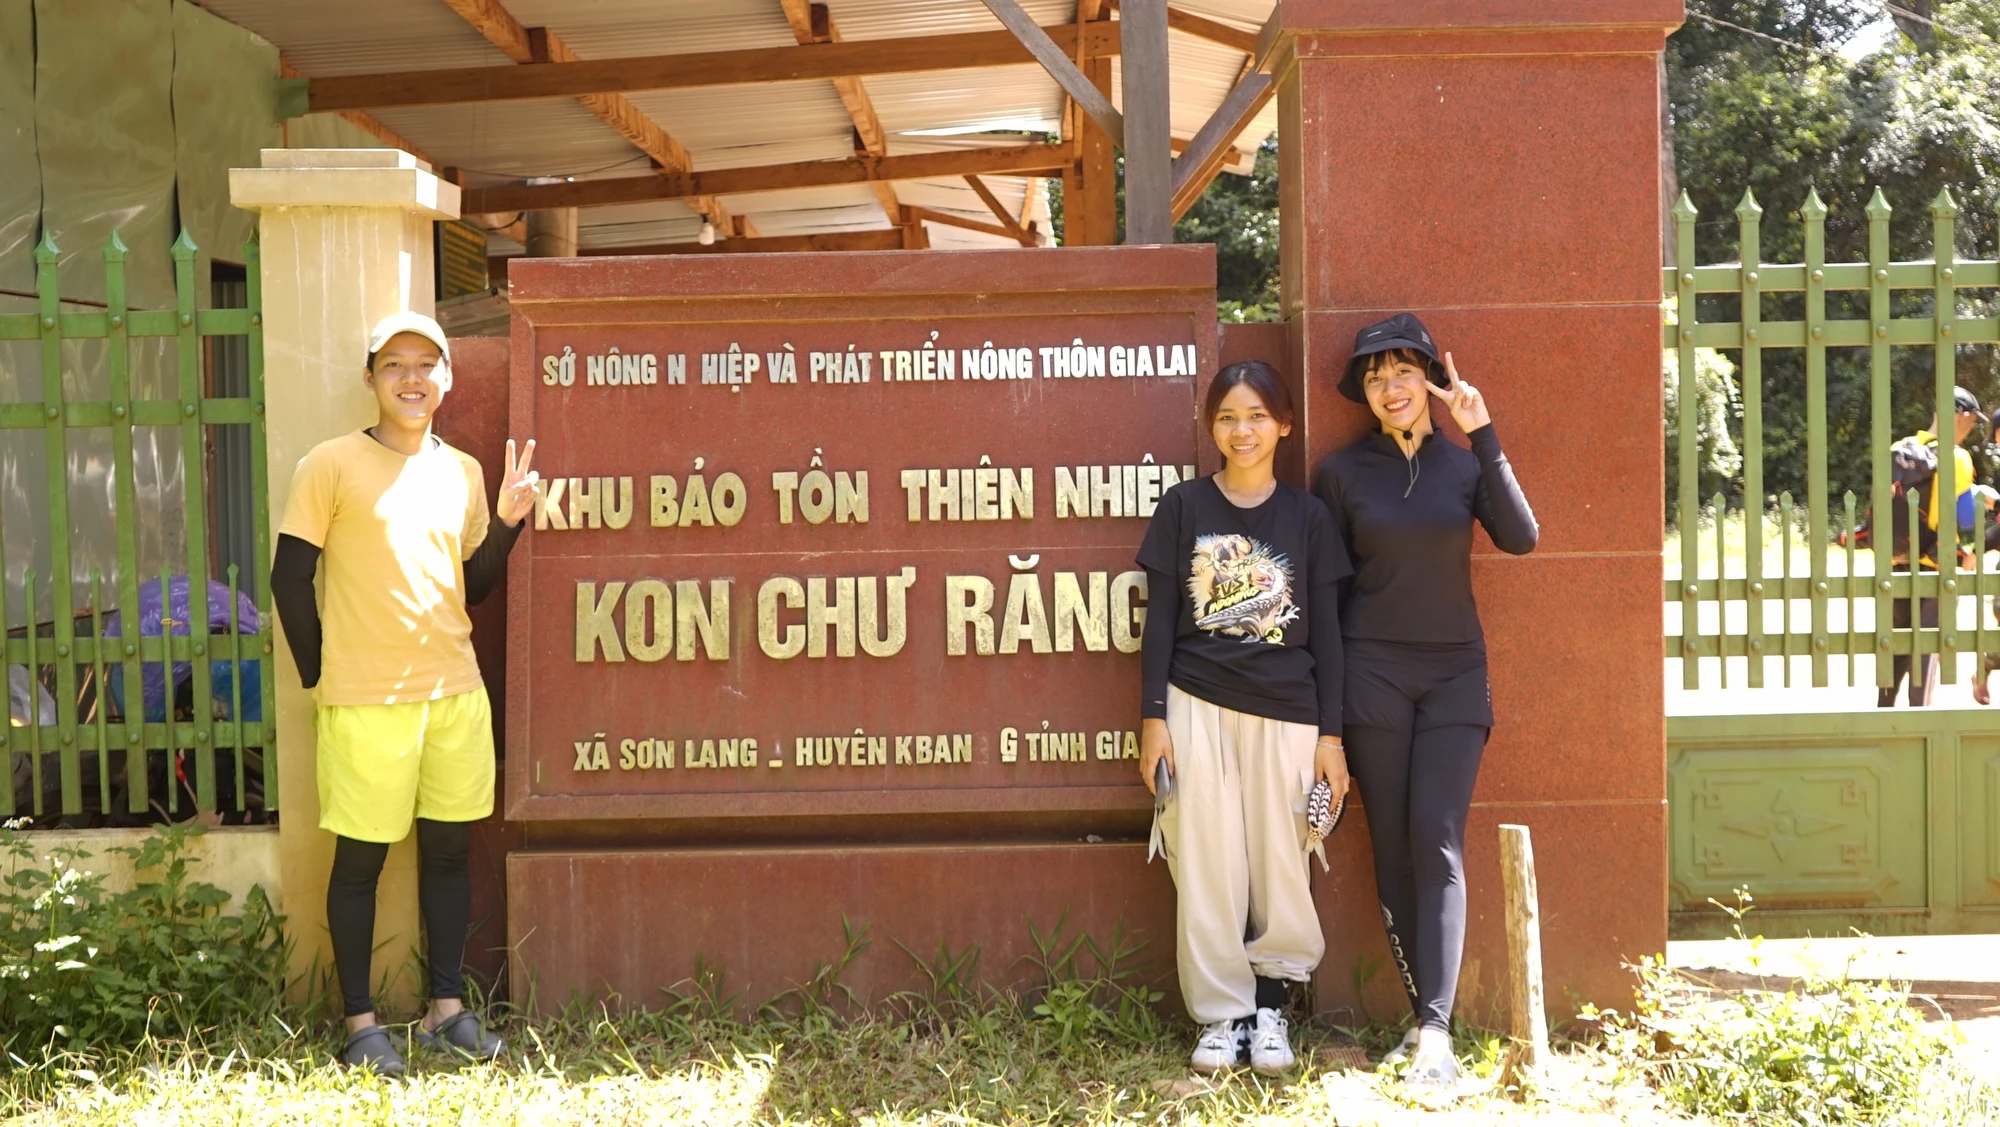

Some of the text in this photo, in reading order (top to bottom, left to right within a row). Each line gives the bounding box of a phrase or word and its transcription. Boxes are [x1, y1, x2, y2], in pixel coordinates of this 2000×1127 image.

[543, 346, 576, 385] SỞ
[587, 347, 656, 385] NÔNG
[668, 354, 686, 383] N
[702, 343, 760, 393] HIỆP
[766, 342, 797, 383] VÀ
[809, 344, 872, 384] PHÁT
[880, 331, 955, 381] TRIỂN
[962, 341, 1032, 380] NÔNG
[1039, 338, 1105, 378] THÔN
[535, 476, 633, 530] KHU
[650, 457, 747, 527] BẢO
[772, 448, 869, 524] TỒN
[901, 455, 1034, 522] THIÊN
[576, 554, 1148, 663] KON CHƯ RĂNG
[573, 732, 610, 771] XÃ
[619, 737, 675, 770] SƠN
[685, 737, 758, 769] LANG
[795, 728, 887, 766] HUYÊN
[1025, 720, 1087, 762] TỈNH
[1095, 730, 1140, 760] GIA
